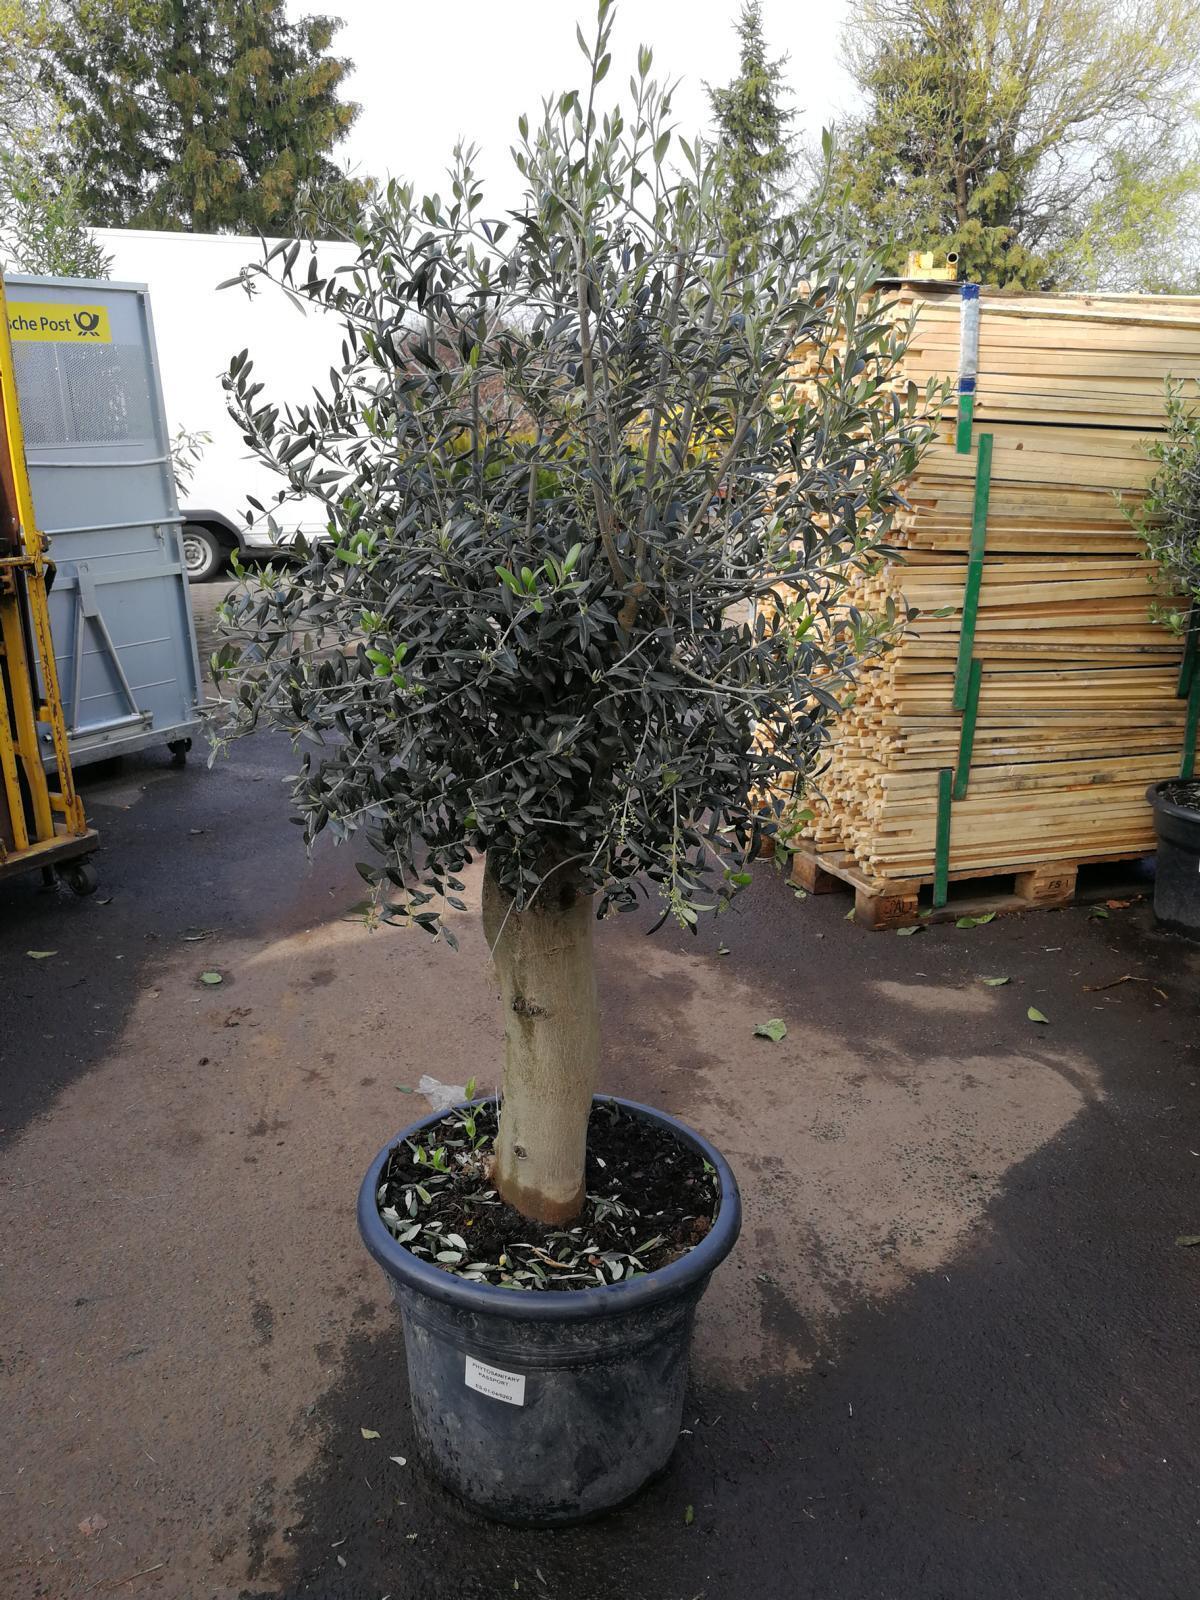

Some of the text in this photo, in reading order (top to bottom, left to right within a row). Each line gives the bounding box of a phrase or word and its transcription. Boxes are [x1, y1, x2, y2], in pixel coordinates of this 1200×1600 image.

[40, 316, 72, 332] Post
[472, 1362, 520, 1383] PHYTOSANITARY
[478, 1372, 509, 1387] PASSPORT
